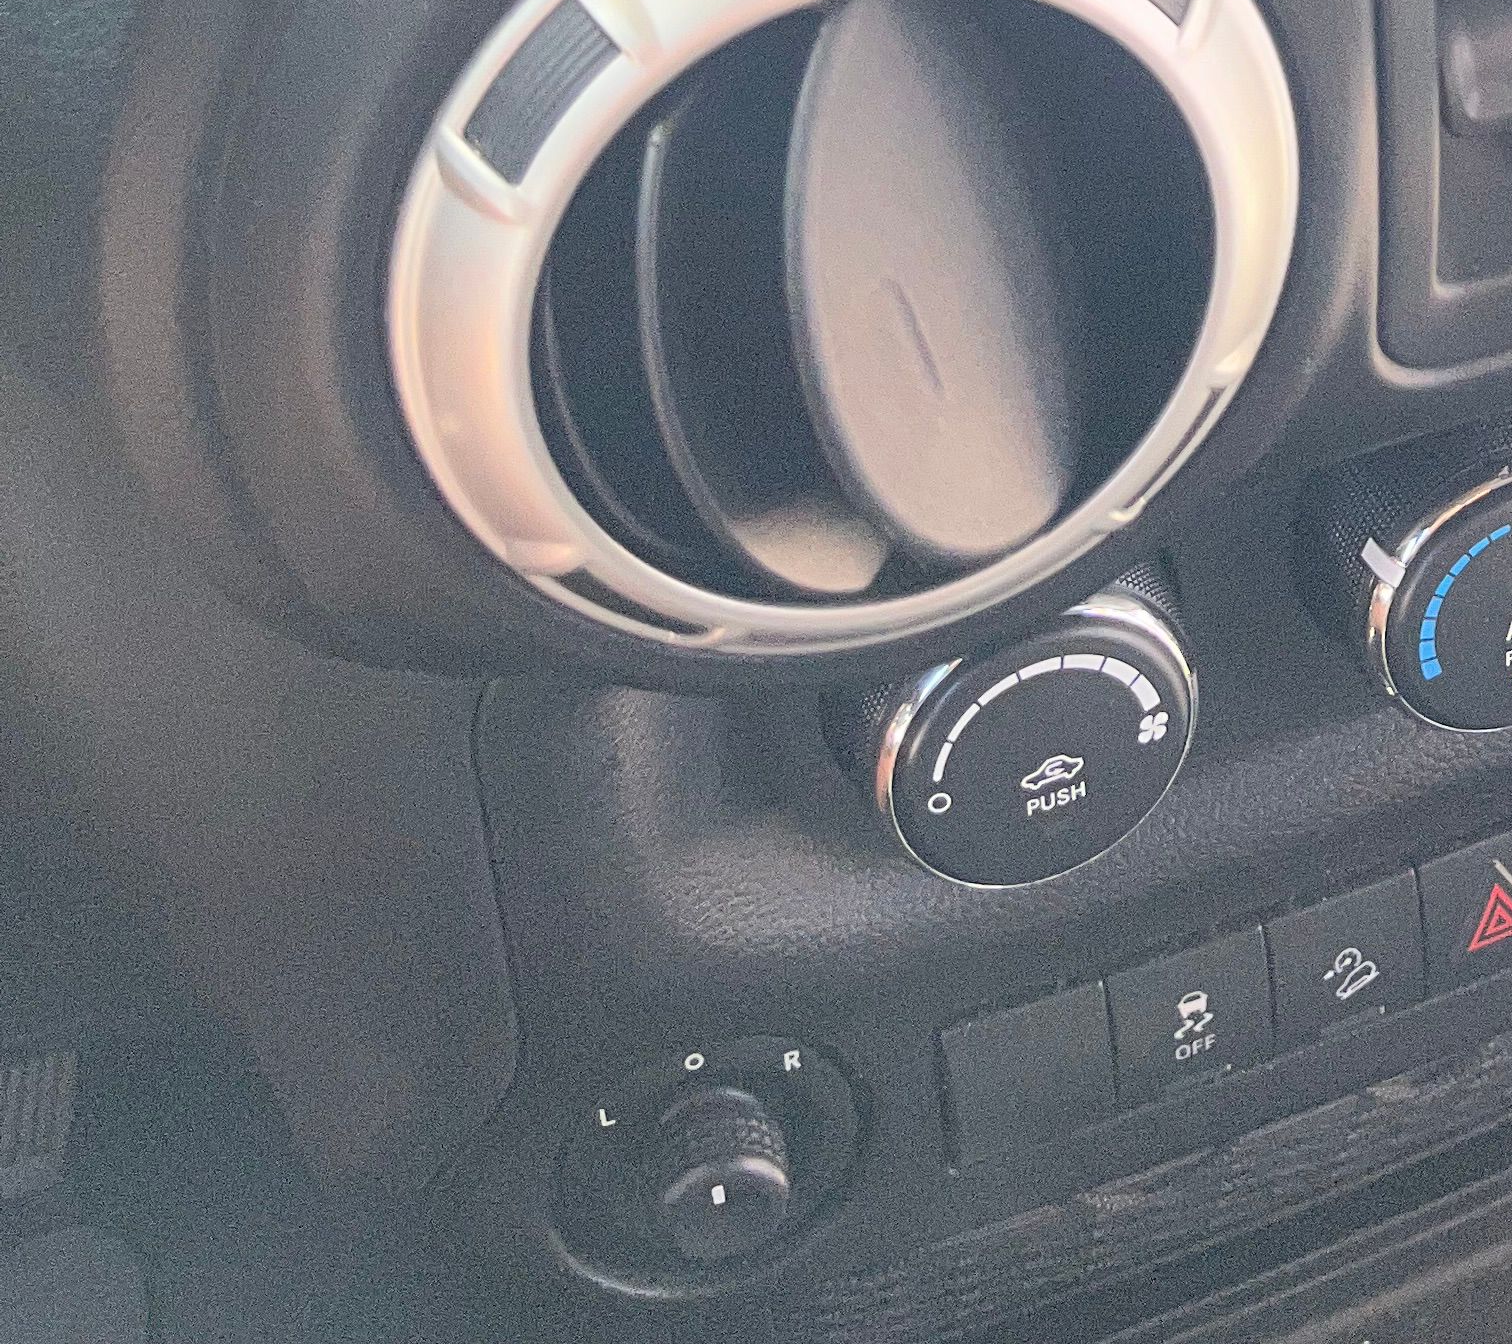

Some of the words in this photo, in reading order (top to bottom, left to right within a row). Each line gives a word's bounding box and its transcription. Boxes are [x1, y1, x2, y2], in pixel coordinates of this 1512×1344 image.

[1025, 781, 1087, 817] PUSH
[1175, 1034, 1216, 1061] OFF
[783, 1050, 801, 1071] R
[598, 1108, 616, 1127] L
